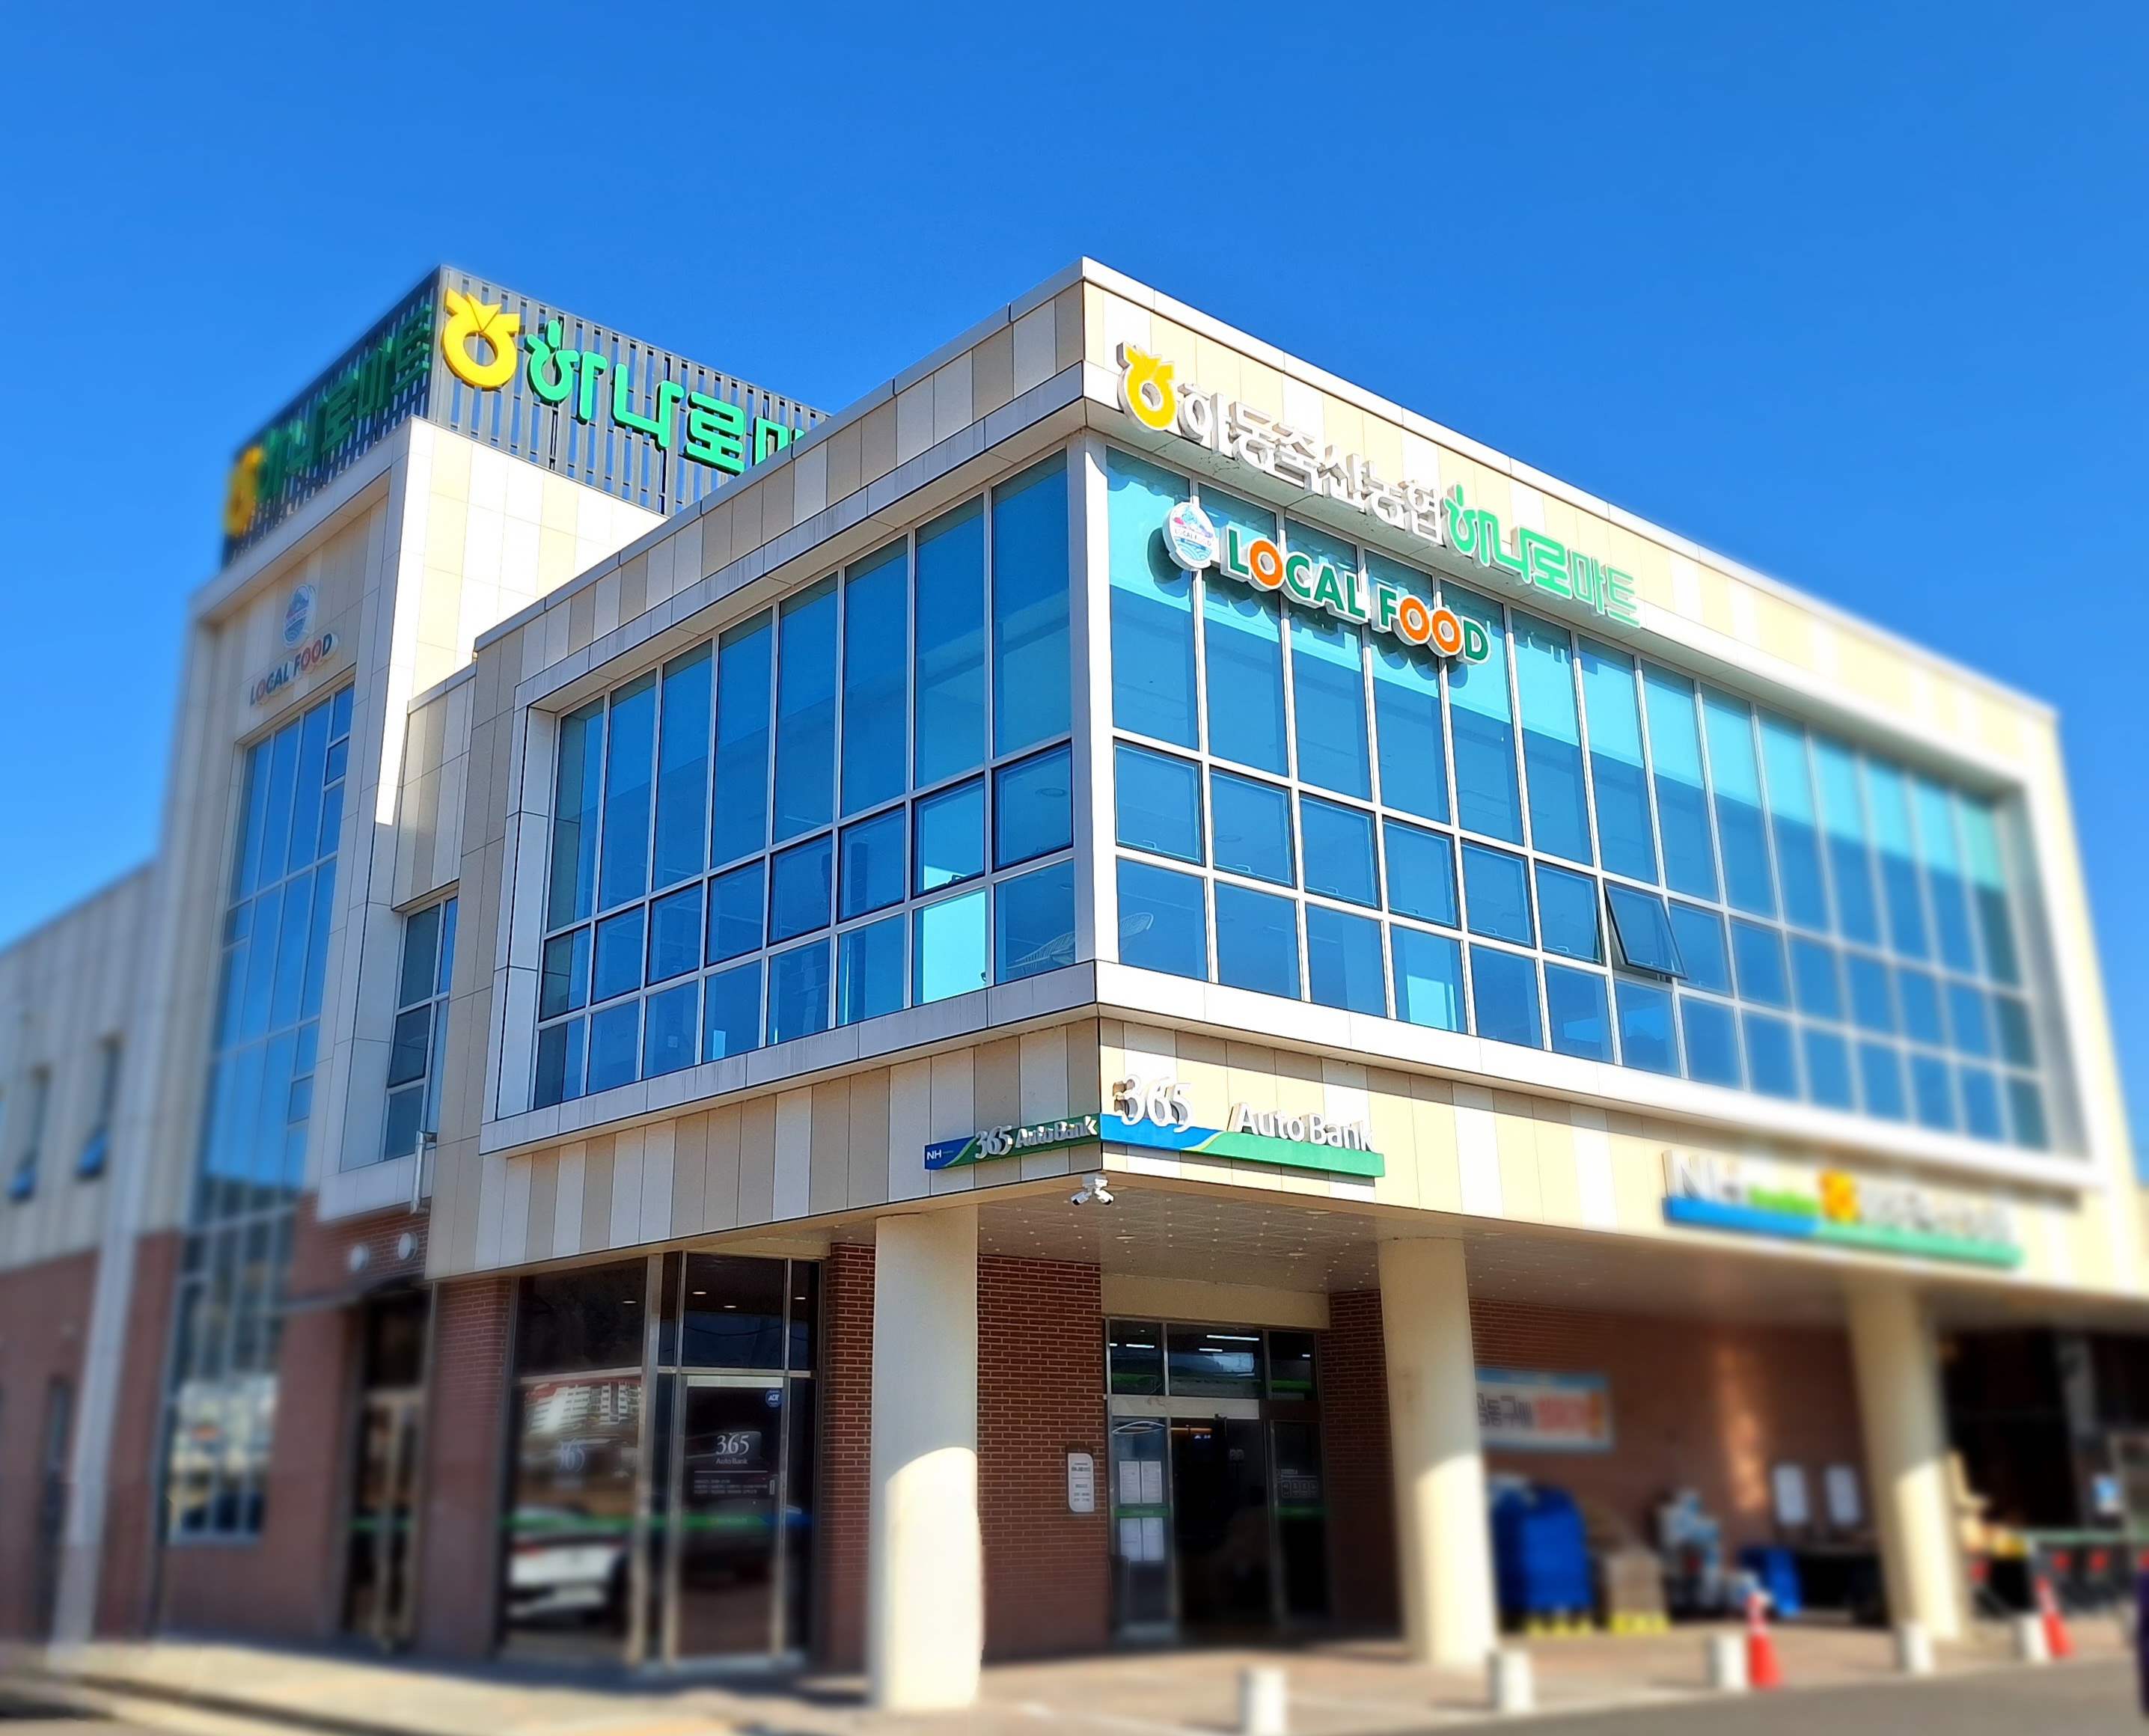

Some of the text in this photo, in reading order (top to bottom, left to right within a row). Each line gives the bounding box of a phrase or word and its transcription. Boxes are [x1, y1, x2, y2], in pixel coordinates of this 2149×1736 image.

[1178, 382, 1645, 629] 하동축산농협 하나로마트
[1225, 526, 1491, 664] LOCAL FOOD
[250, 633, 333, 706] LOCAL FOOD
[1113, 1074, 1193, 1133] 365
[926, 1149, 942, 1161] NH
[974, 1125, 1014, 1159] 365
[716, 1434, 750, 1455] 365
